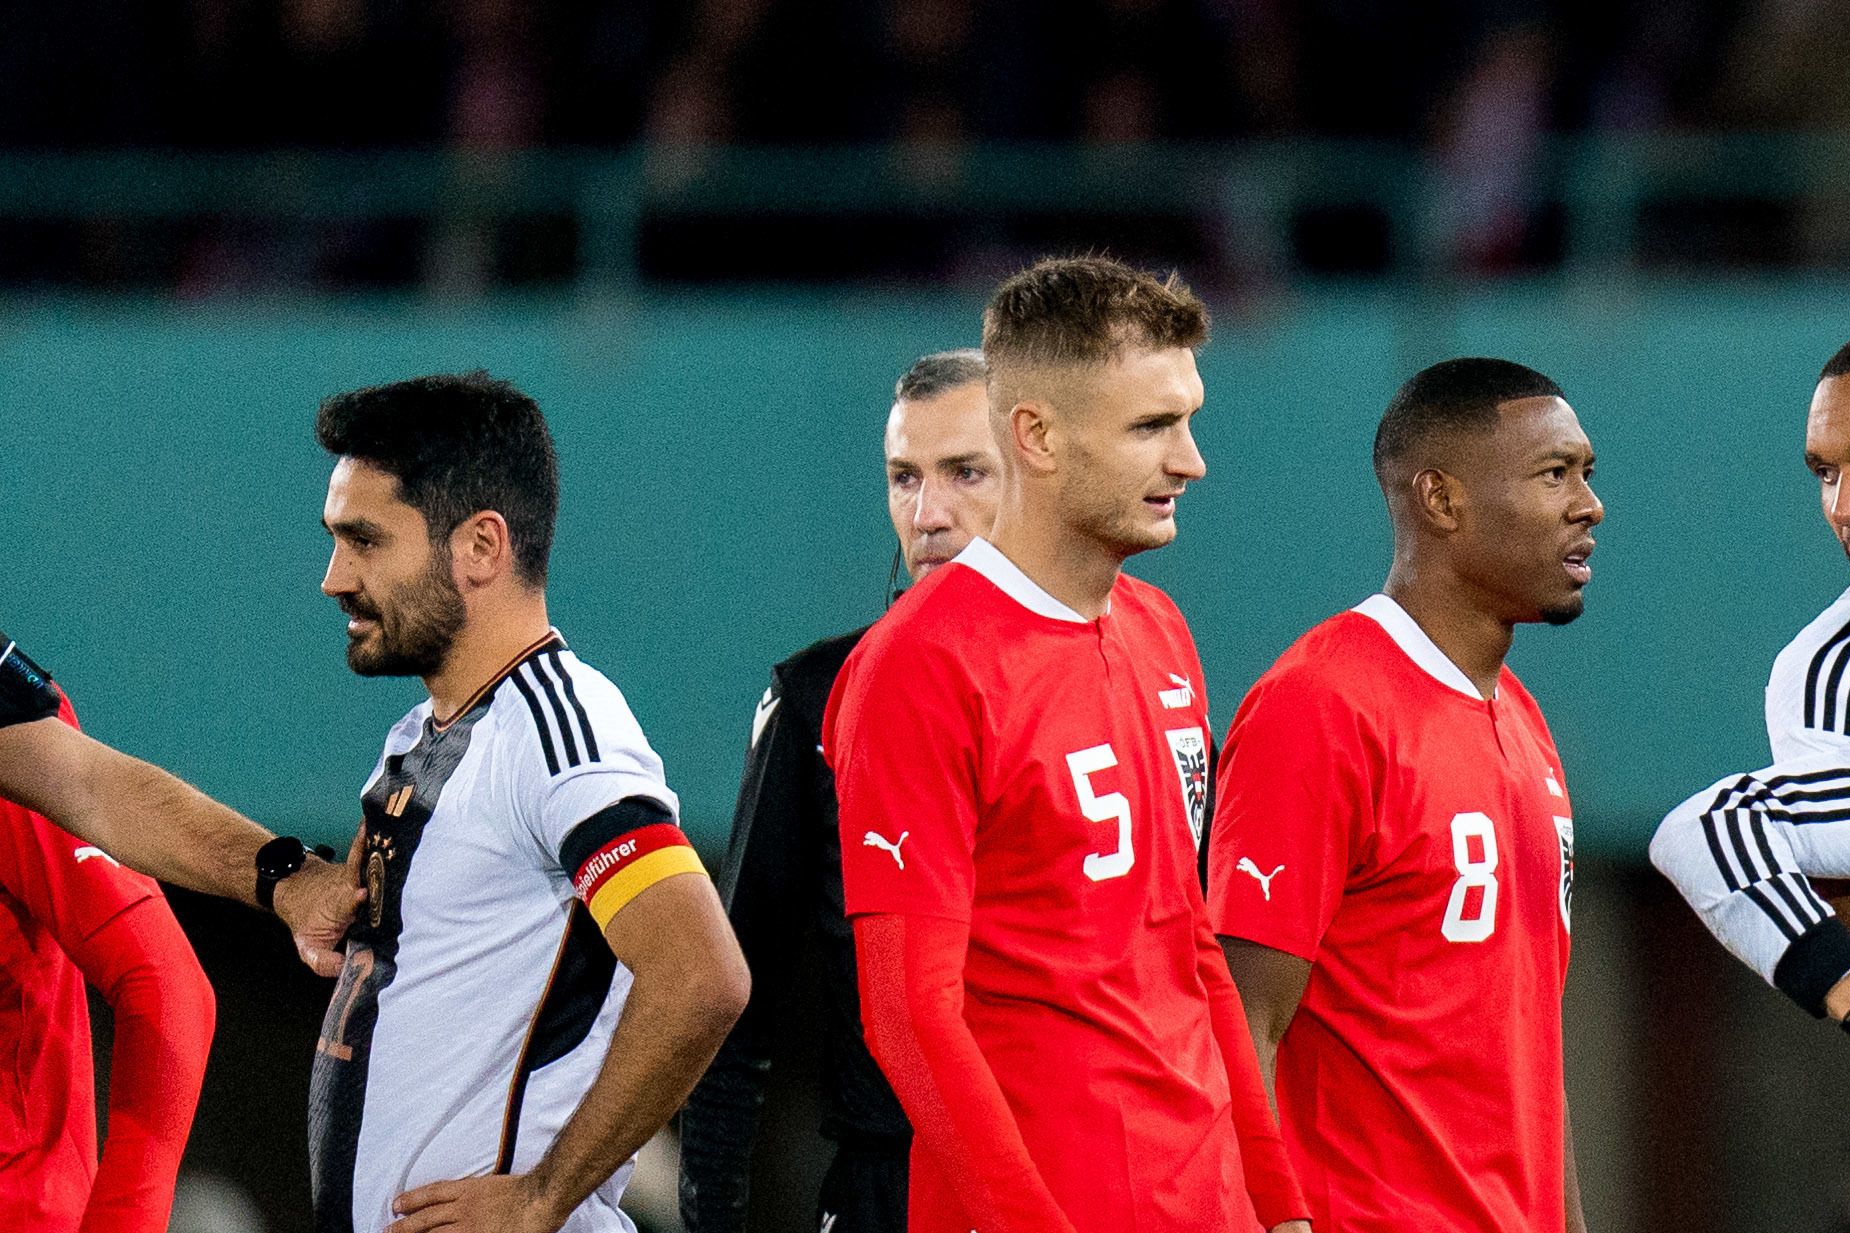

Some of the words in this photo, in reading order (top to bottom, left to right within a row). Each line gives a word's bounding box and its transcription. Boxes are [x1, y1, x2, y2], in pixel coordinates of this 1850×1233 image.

[577, 838, 637, 901] pielführer
[1065, 743, 1135, 882] 5
[1440, 811, 1499, 943] 8
